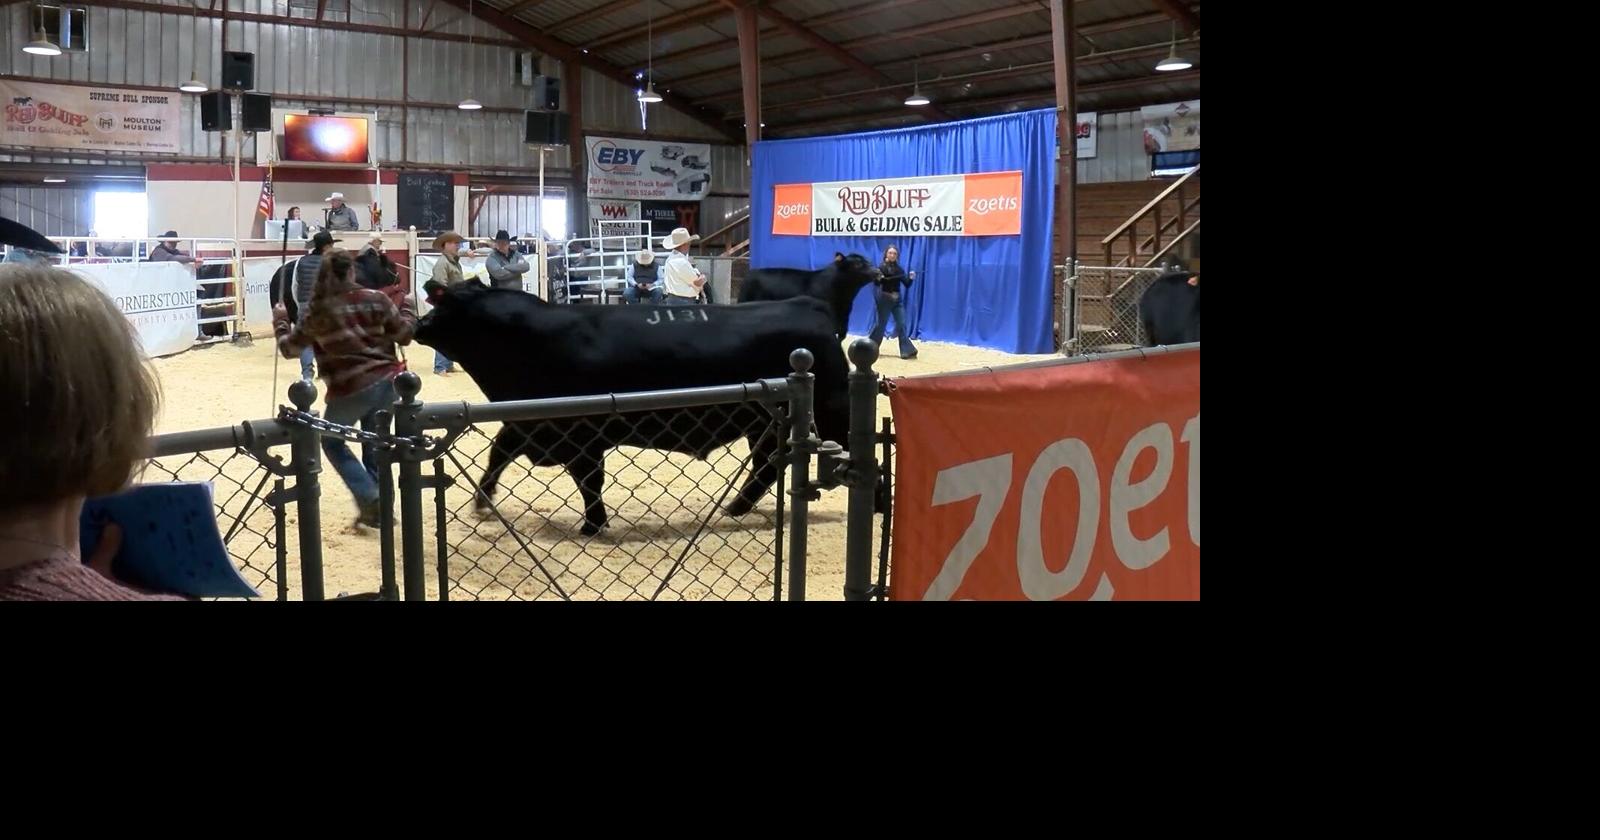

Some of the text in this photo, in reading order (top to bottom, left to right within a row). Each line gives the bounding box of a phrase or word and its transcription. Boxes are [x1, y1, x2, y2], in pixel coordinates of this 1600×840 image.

[89, 91, 168, 104] SUPREME BULL SPONSOR
[5, 102, 89, 127] RED BLUFF
[123, 117, 161, 125] MOULTON
[123, 124, 161, 132] MUSEUM
[598, 147, 645, 166] EBY
[838, 184, 931, 215] RED BLUFF
[815, 215, 962, 233] BULL & GELDING SALE
[114, 290, 196, 311] ORNERSTONE
[646, 309, 709, 325] J131
